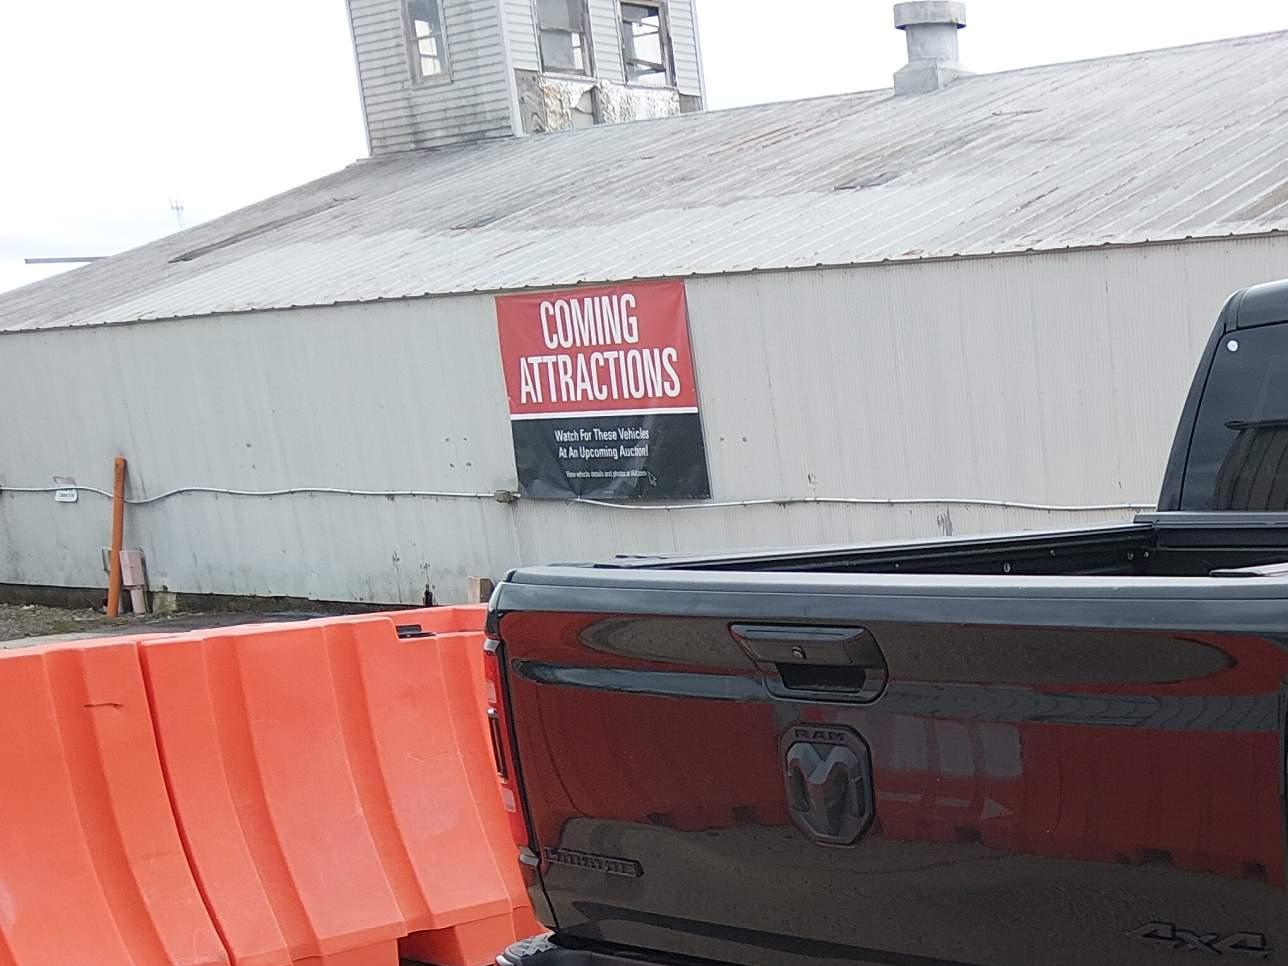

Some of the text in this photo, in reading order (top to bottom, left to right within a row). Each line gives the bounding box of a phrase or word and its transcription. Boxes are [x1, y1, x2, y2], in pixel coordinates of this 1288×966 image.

[540, 293, 639, 349] COMING
[520, 347, 681, 404] ATTRACTIONS
[554, 427, 649, 442] Watch For These Vehicles
[559, 444, 649, 460] At An Upcoming Auction!
[795, 728, 846, 741] RAM
